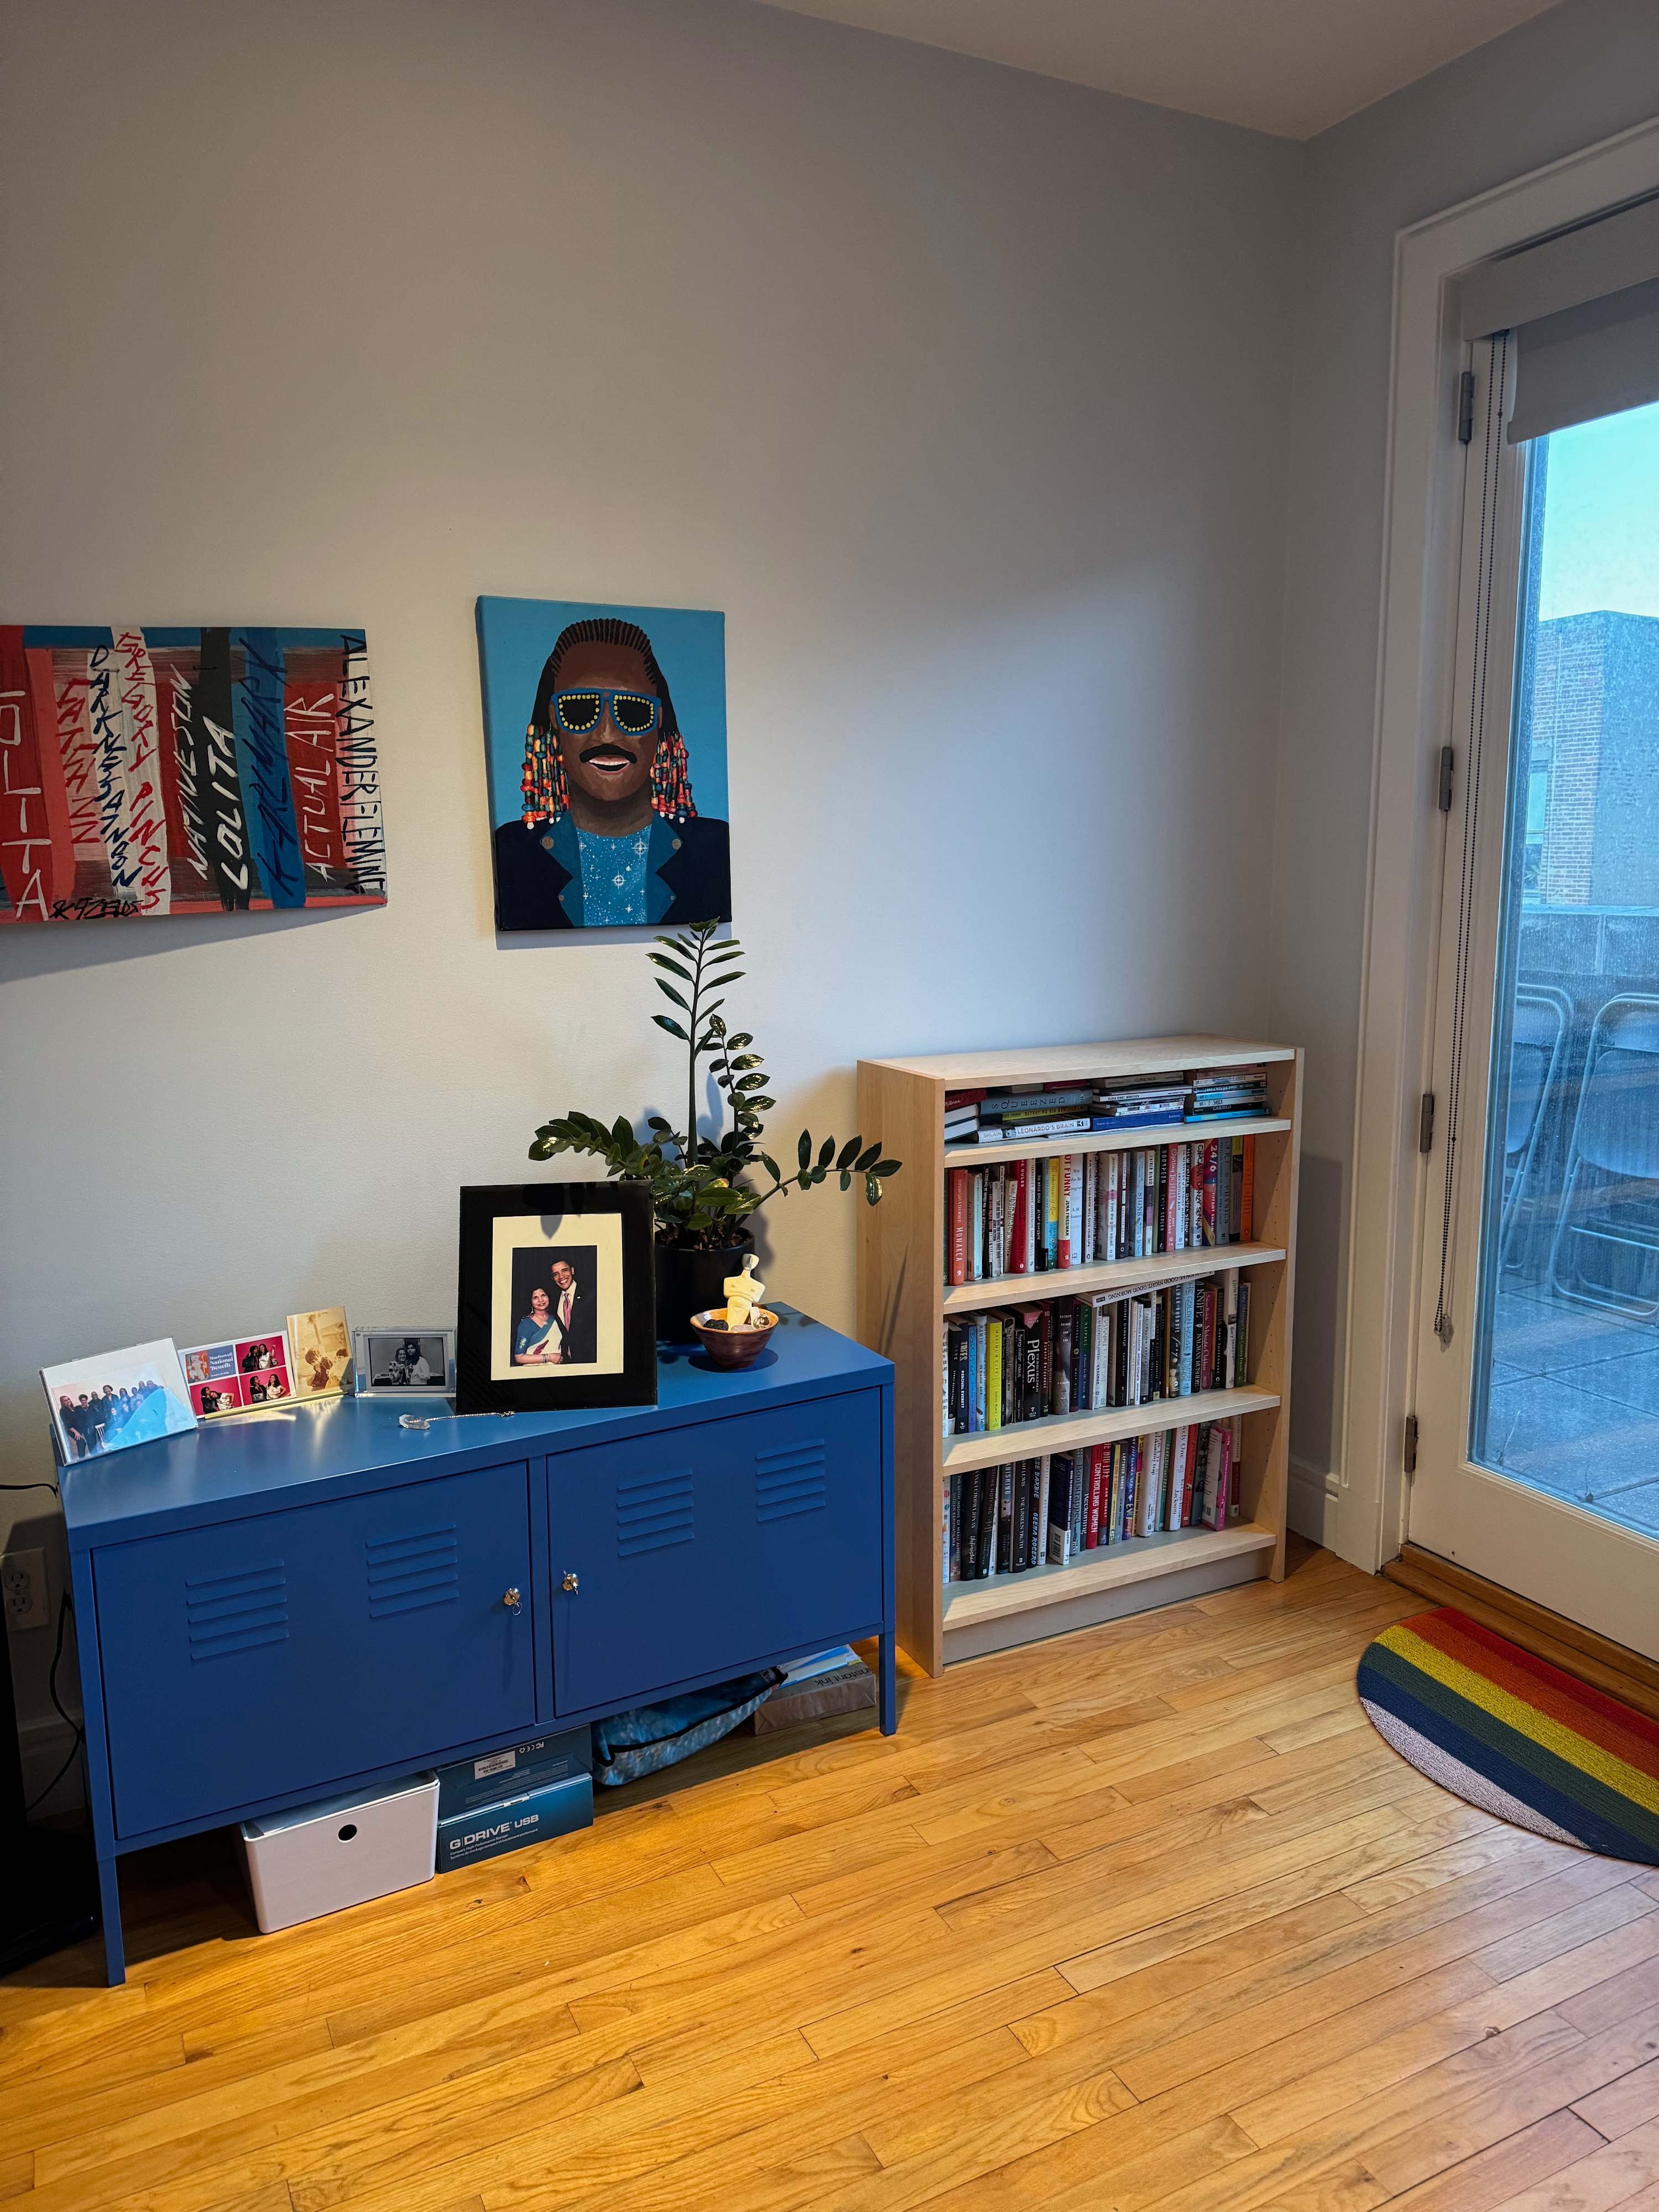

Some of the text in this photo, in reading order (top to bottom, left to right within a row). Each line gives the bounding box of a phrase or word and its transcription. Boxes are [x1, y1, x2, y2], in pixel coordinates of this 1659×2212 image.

[284, 693, 335, 753] AIR
[202, 716, 249, 891] LOLITA
[992, 1097, 1066, 1109] SQUEEZED
[1018, 1124, 1055, 1134] LEONARDO'S
[956, 1226, 964, 1261] MONARCA
[1108, 1289, 1132, 1300] MORNING
[1147, 1280, 1163, 1289] NIGHT
[210, 1357, 233, 1365] National
[1027, 1339, 1039, 1383] Plexus
[1073, 1464, 1082, 1524] Bootstrapped
[1092, 1463, 1101, 1506] CONTROLLING
[1081, 1493, 1089, 1535] Reckoning
[814, 1677, 834, 1686] ink
[514, 1814, 539, 1828] USB
